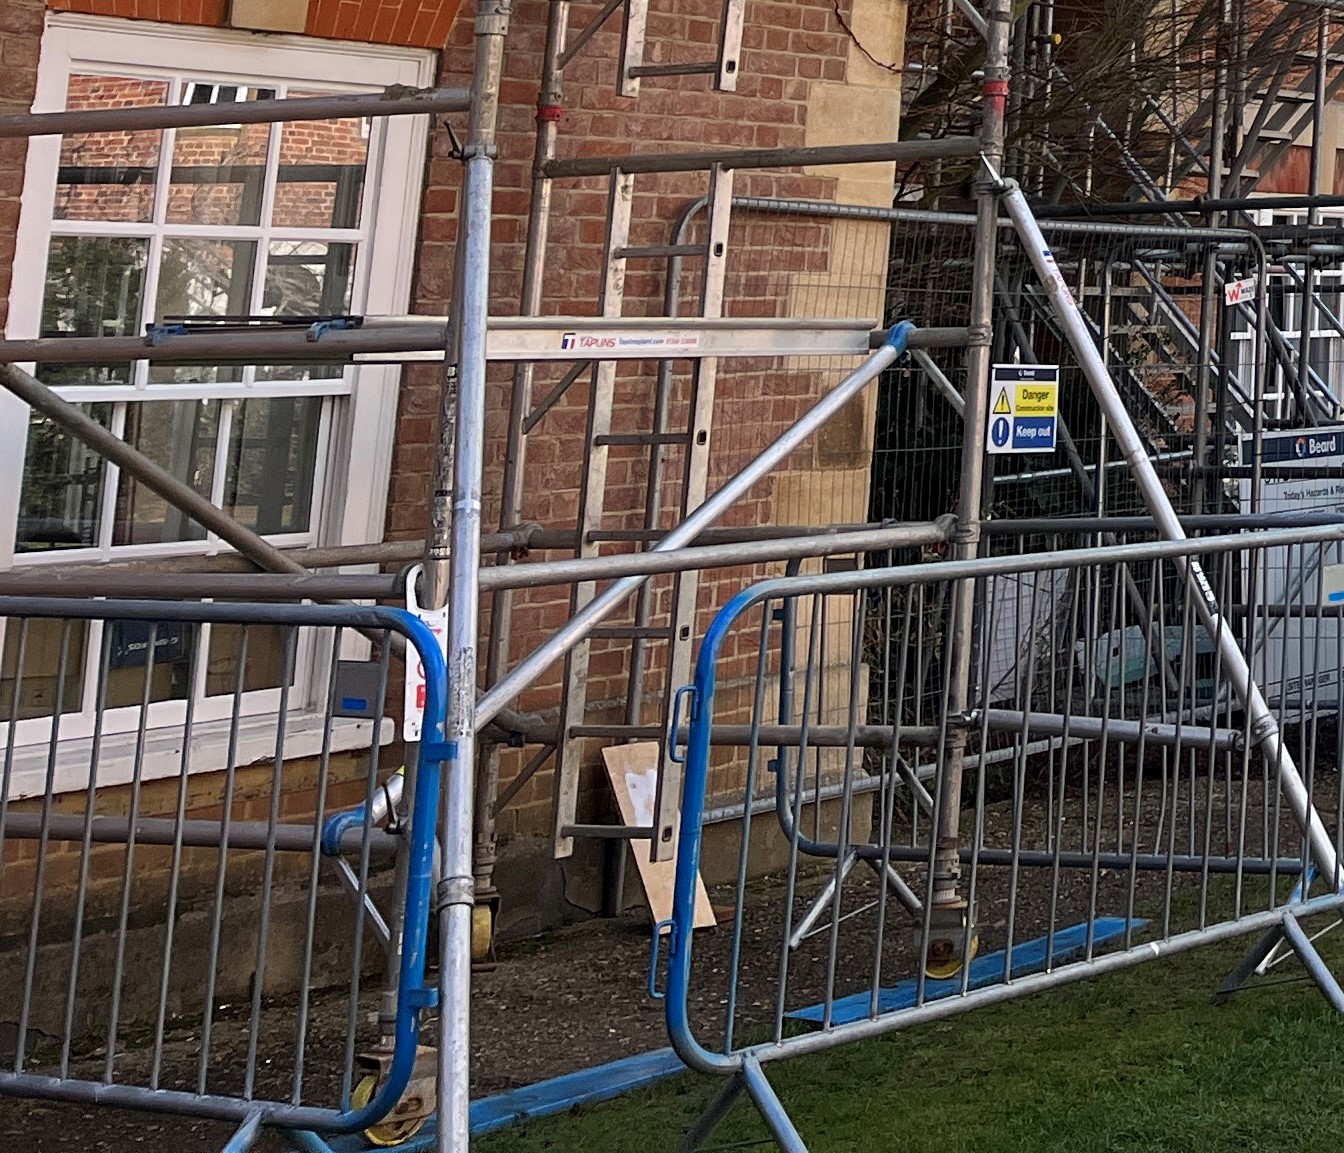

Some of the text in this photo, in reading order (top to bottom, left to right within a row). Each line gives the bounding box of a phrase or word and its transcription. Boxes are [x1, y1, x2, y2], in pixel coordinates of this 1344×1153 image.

[1022, 389, 1050, 402] Danger
[1016, 426, 1051, 439] Keep out
[1309, 436, 1336, 454] Beard
[1283, 490, 1305, 501] Today's
[1306, 486, 1329, 497] Hazards
